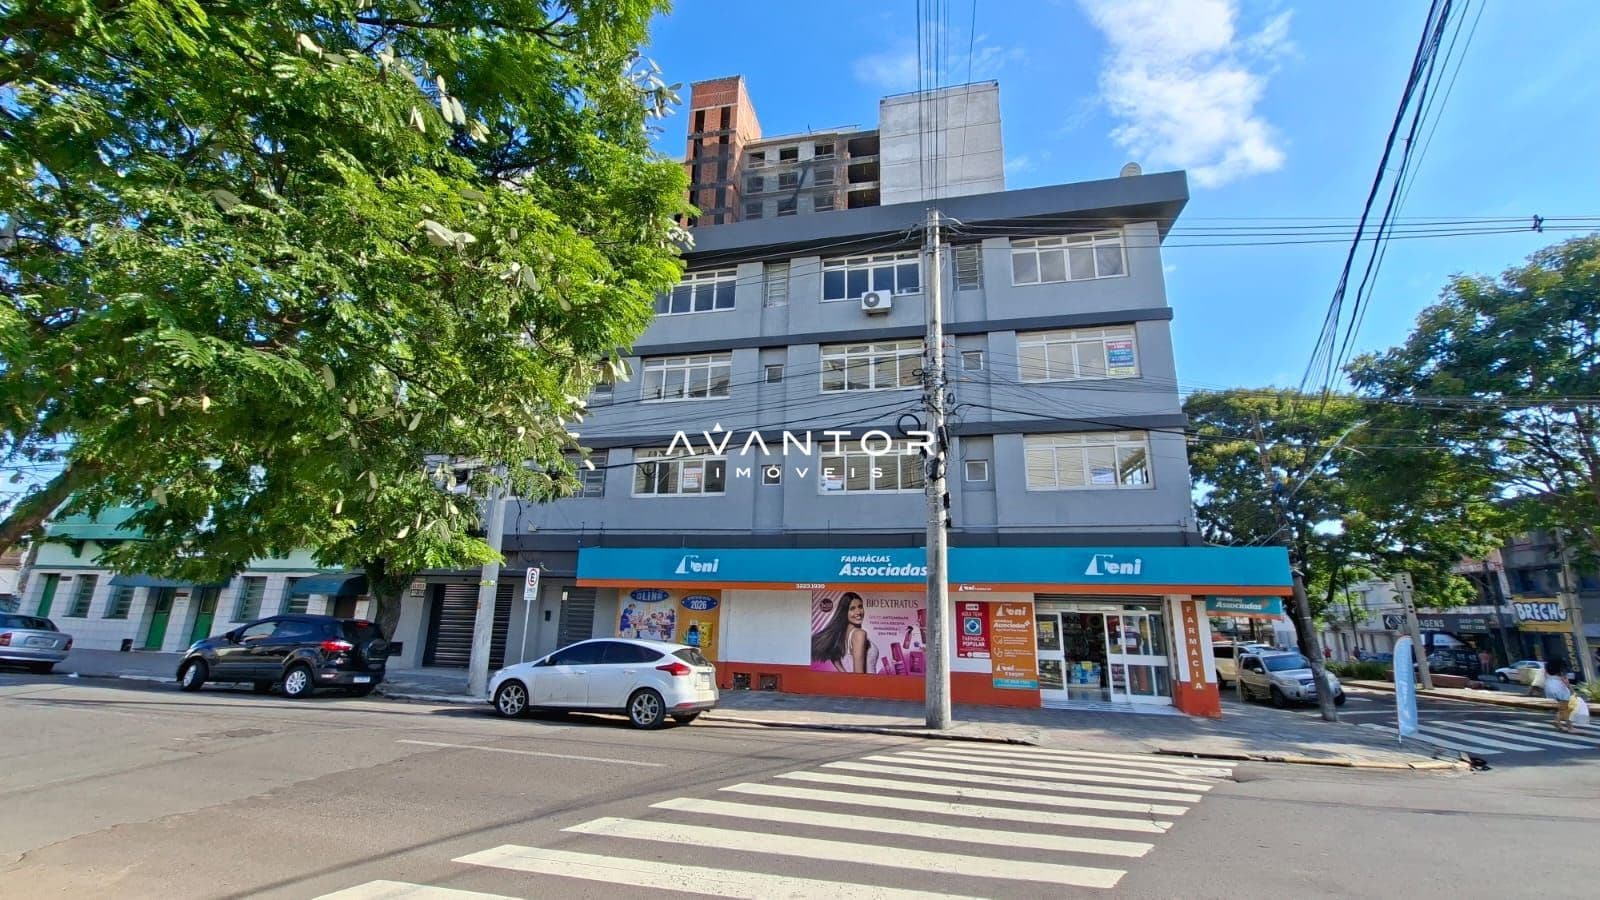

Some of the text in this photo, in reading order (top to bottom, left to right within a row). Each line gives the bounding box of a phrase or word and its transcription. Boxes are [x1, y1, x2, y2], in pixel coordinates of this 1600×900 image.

[838, 563, 928, 577] Associadas
[690, 600, 707, 610] 2026
[866, 599, 919, 609] BIO EXTRATUS
